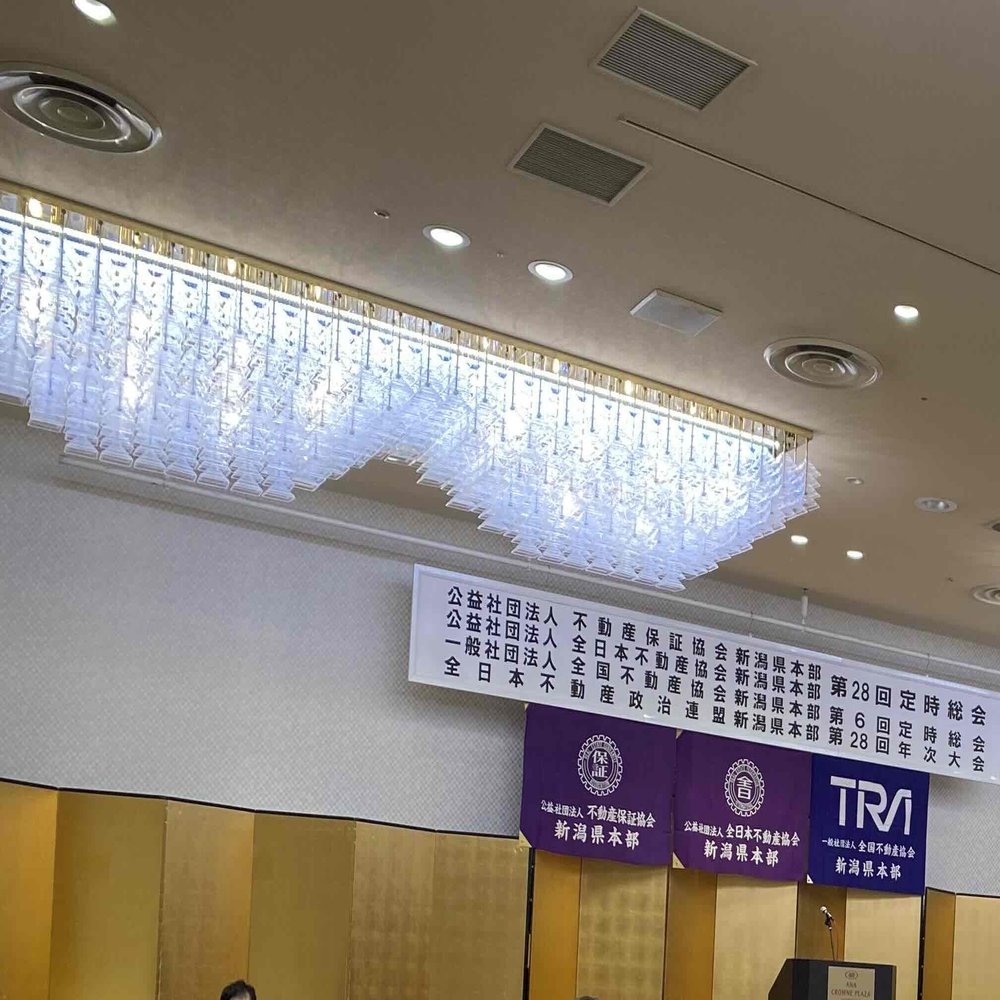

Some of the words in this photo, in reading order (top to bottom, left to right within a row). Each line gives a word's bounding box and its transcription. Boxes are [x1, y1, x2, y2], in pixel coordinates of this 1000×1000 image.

[447, 586, 558, 627] 公益社団法人
[446, 609, 557, 649] 公益社団法人
[444, 635, 557, 671] 一般社団法人
[829, 706, 985, 753] 第6回定時総会
[830, 674, 986, 726] 第28回定時総会
[828, 727, 985, 773] 第28回年次大会
[587, 804, 656, 829] 不動産保証協会
[554, 819, 640, 850] 新潟県本部
[725, 823, 801, 847] 全日本不動産協会
[703, 839, 779, 867] 新潟県本部
[835, 856, 902, 880] 新潟県本部
[854, 990, 871, 998] PLAZA
